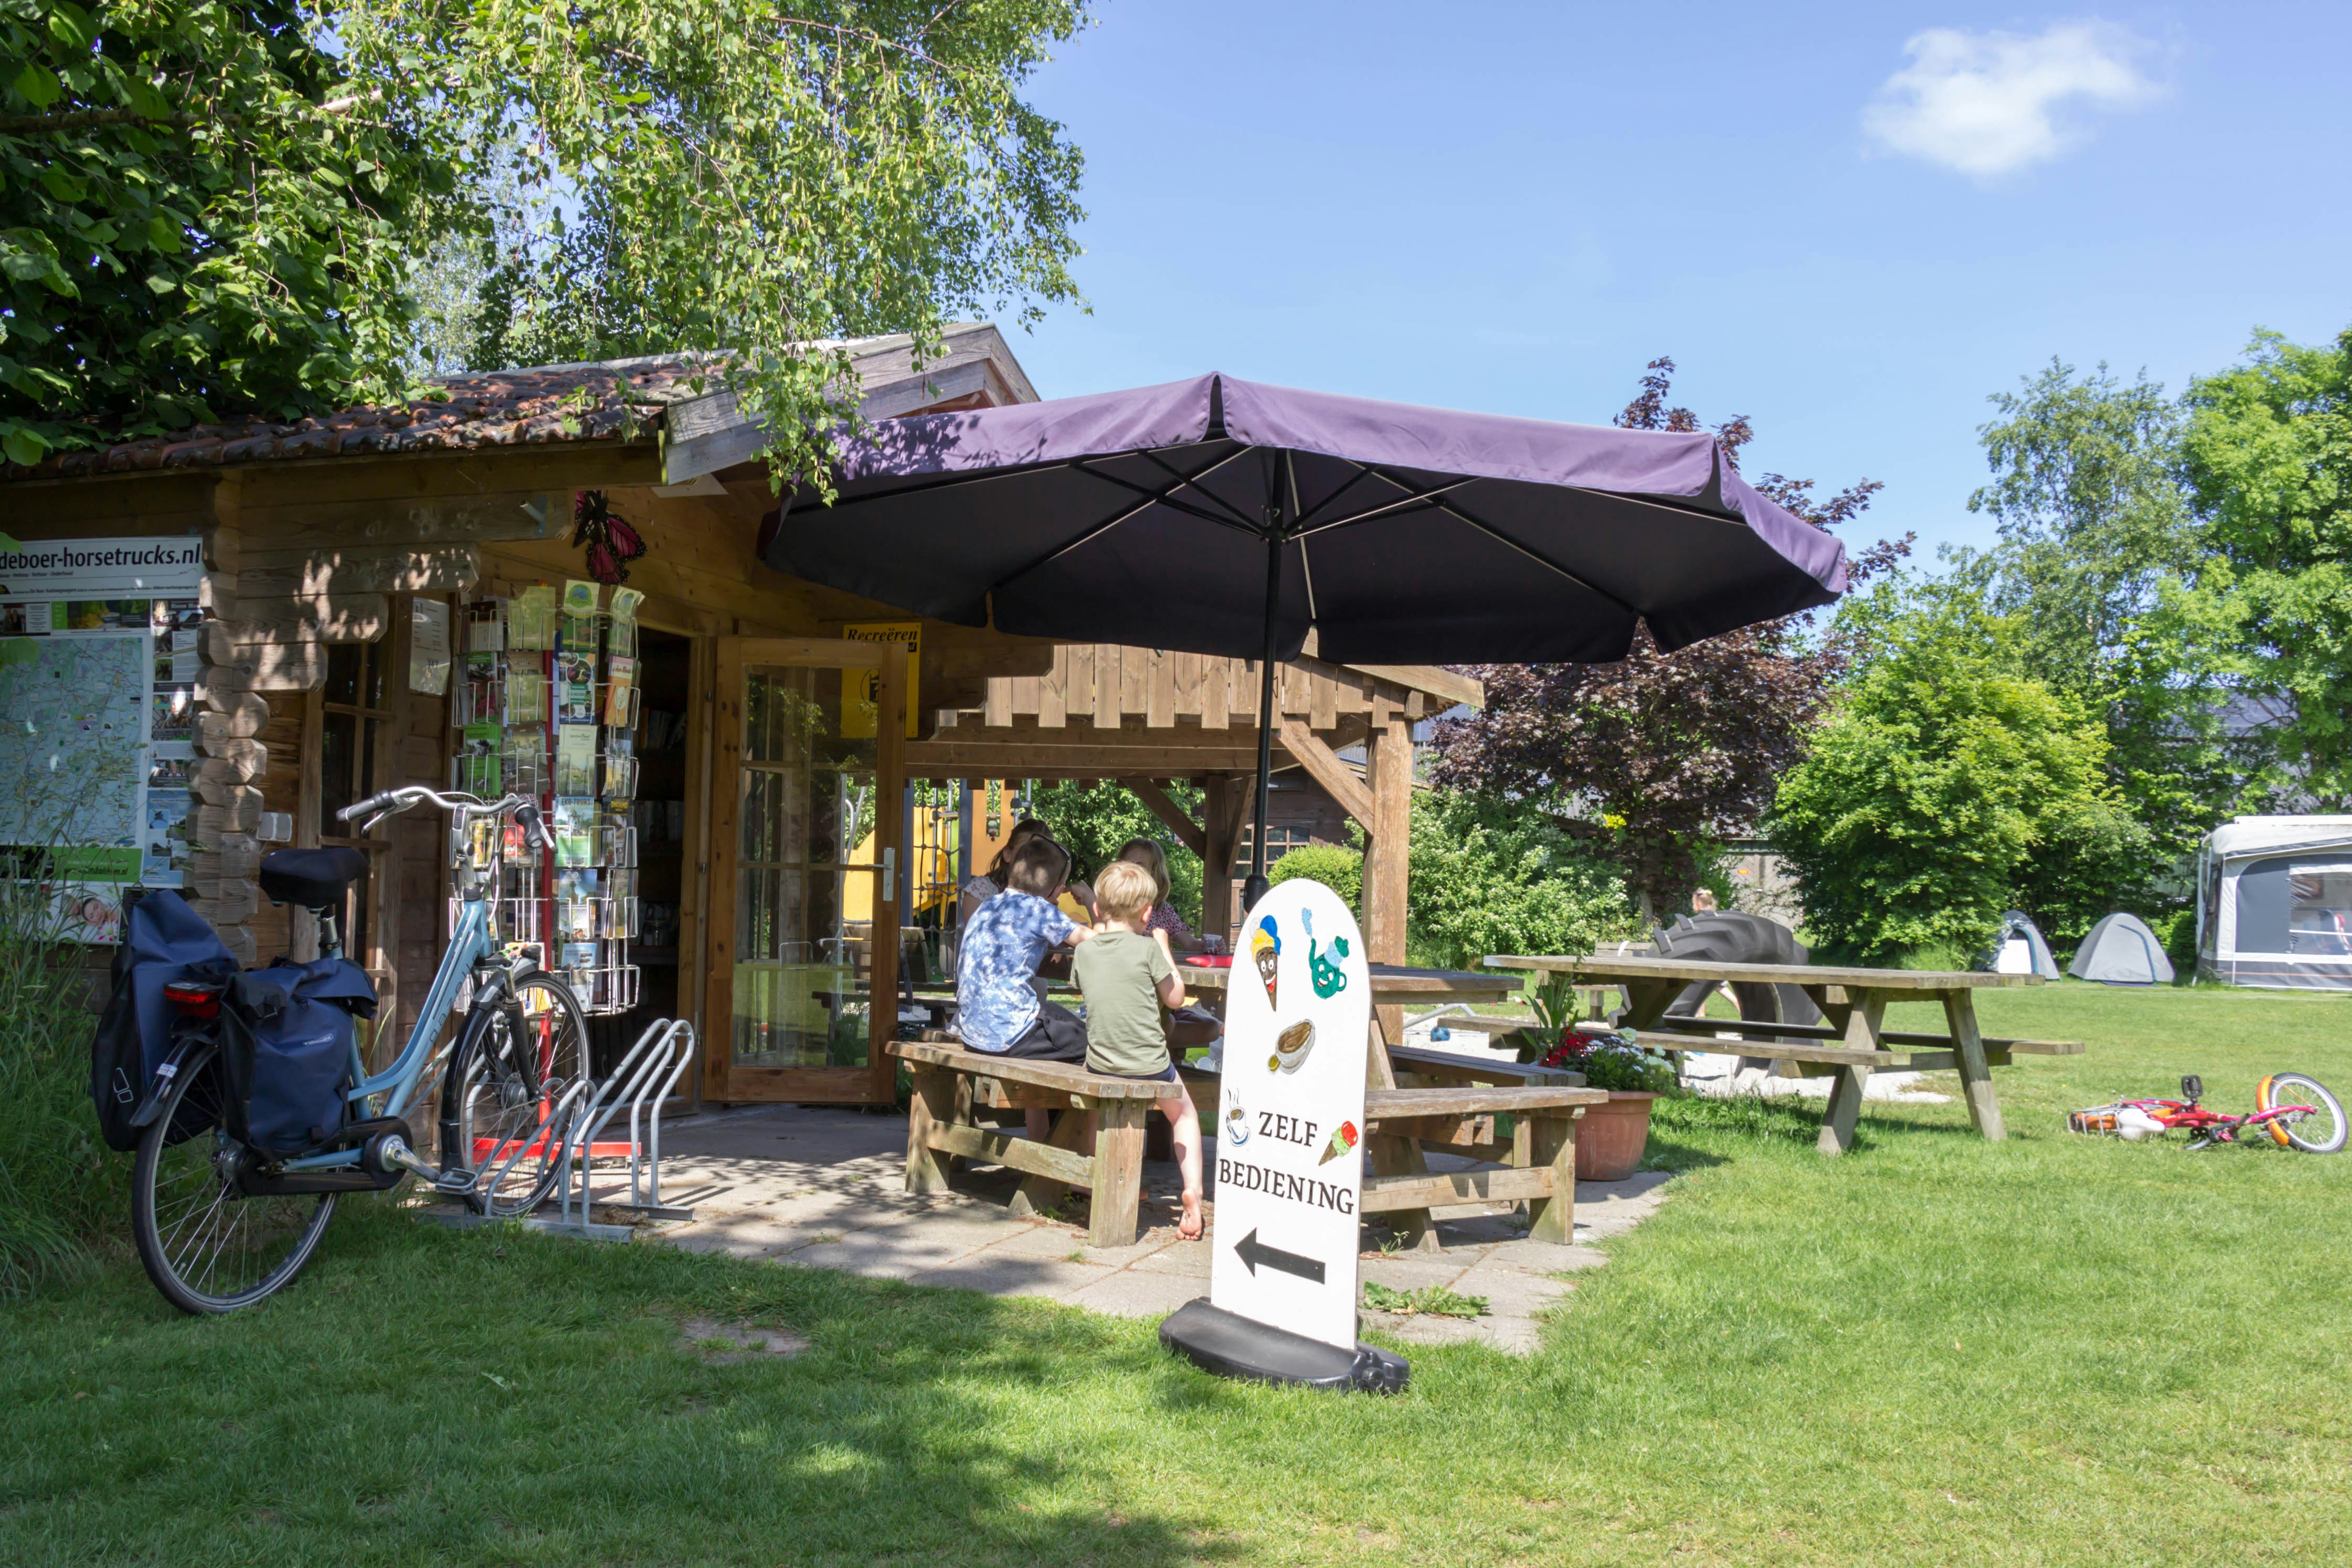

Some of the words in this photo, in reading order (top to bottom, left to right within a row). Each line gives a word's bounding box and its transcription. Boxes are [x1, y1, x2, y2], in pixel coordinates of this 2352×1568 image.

[0, 543, 200, 569] deboer-horsetrucks.nl
[847, 628, 917, 641] Recreëren
[1258, 1111, 1317, 1147] ZELF
[1219, 1158, 1354, 1215] BEDIENING
